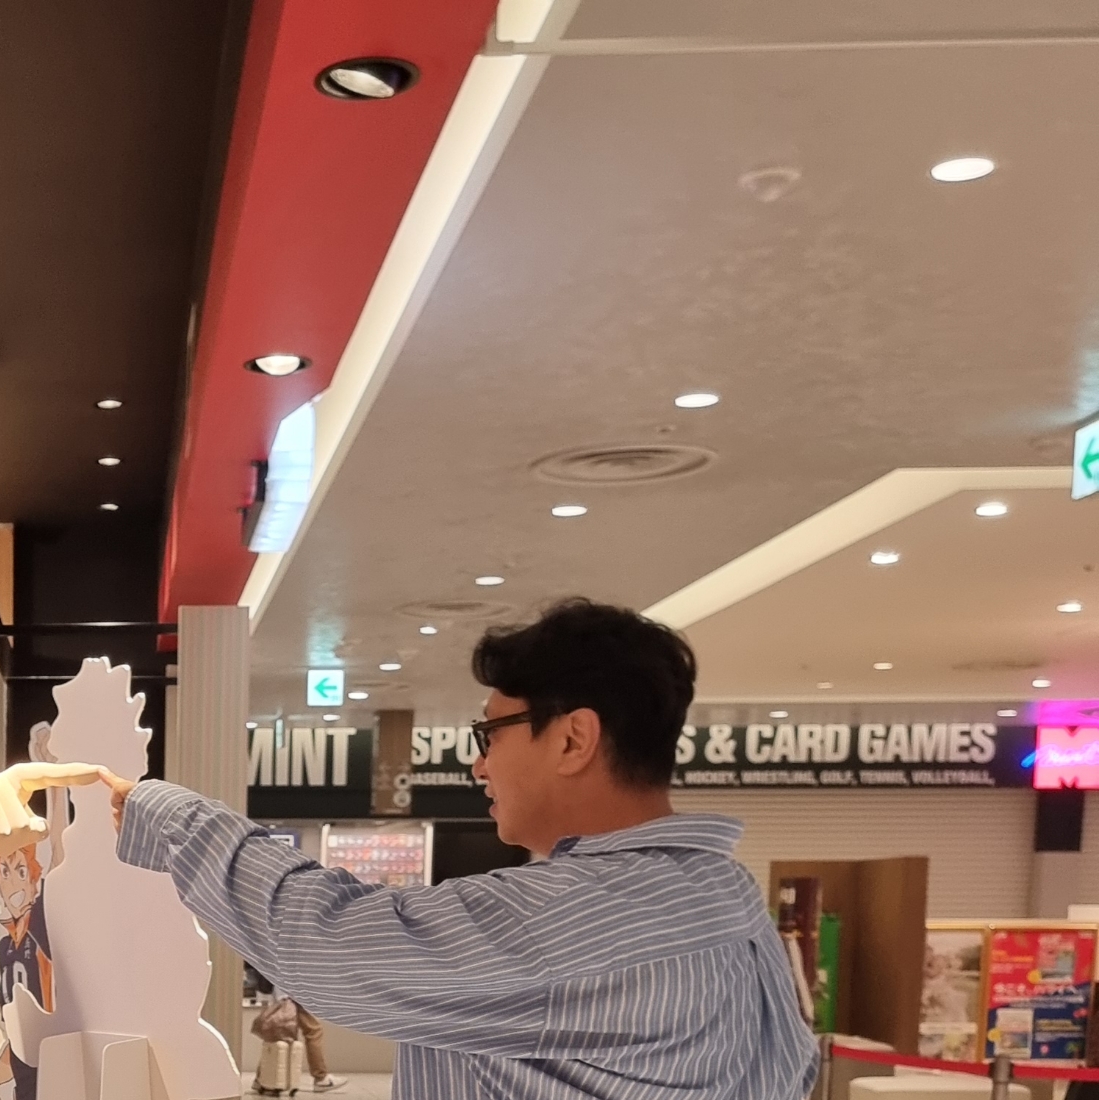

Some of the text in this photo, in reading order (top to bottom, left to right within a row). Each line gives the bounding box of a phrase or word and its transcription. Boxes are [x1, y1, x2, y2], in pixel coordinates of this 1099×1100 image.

[704, 723, 737, 764] &
[745, 723, 851, 764] CARD
[857, 722, 996, 765] GAMES
